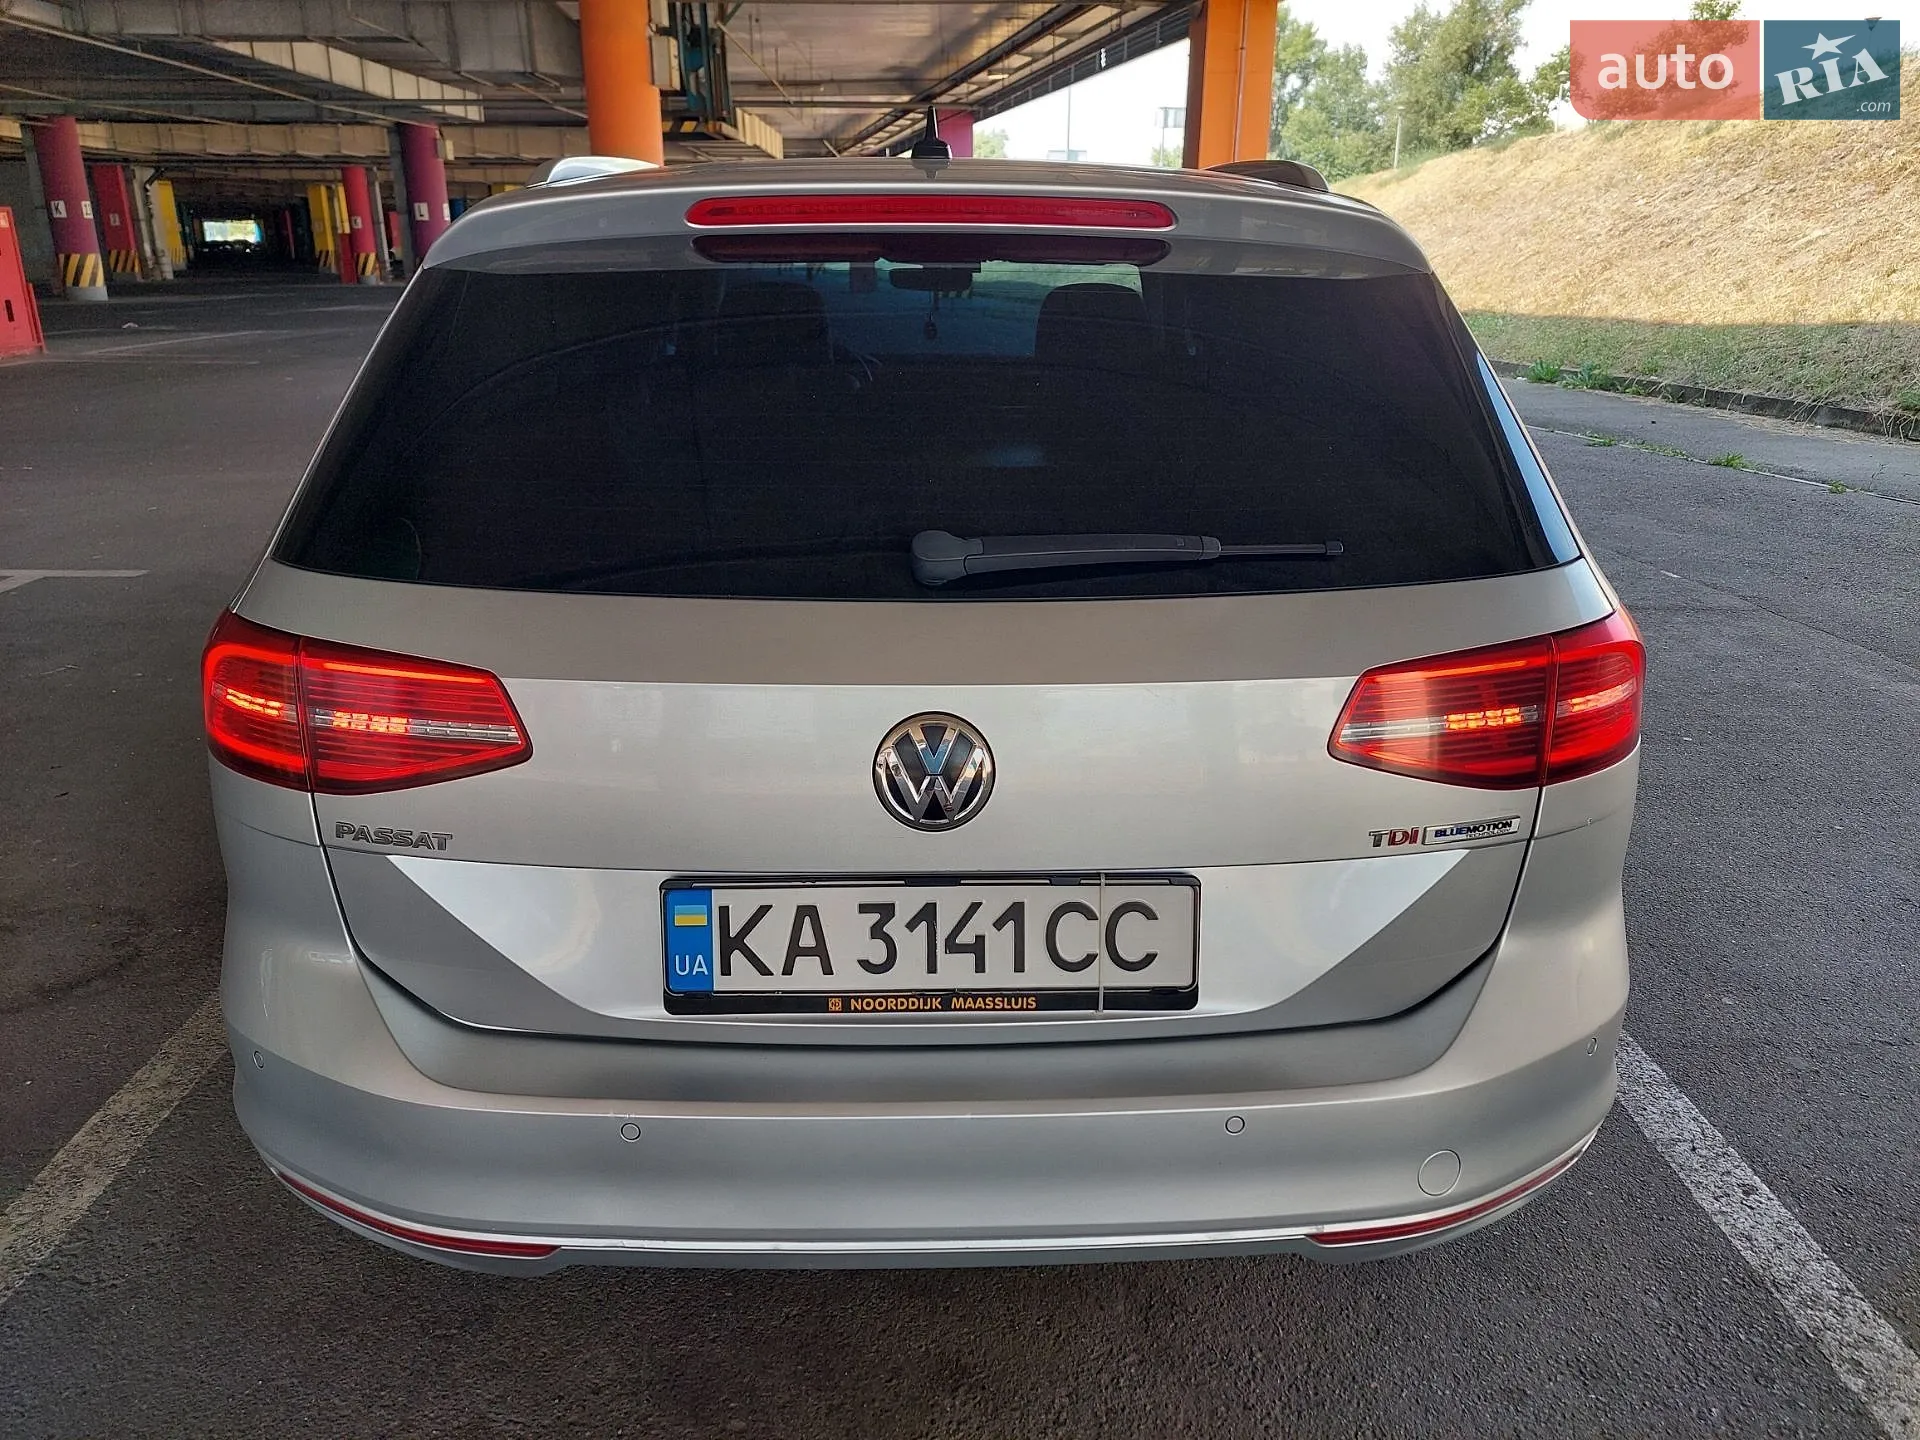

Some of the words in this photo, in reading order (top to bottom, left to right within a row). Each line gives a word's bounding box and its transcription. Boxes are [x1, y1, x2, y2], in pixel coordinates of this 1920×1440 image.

[335, 821, 453, 851] PASSAT
[1368, 827, 1420, 848] TDI
[1434, 820, 1512, 838] BLUEMOTION
[674, 953, 709, 976] UA
[850, 997, 942, 1011] NOORDDIJK
[950, 996, 1037, 1011] MAASSLUIS
